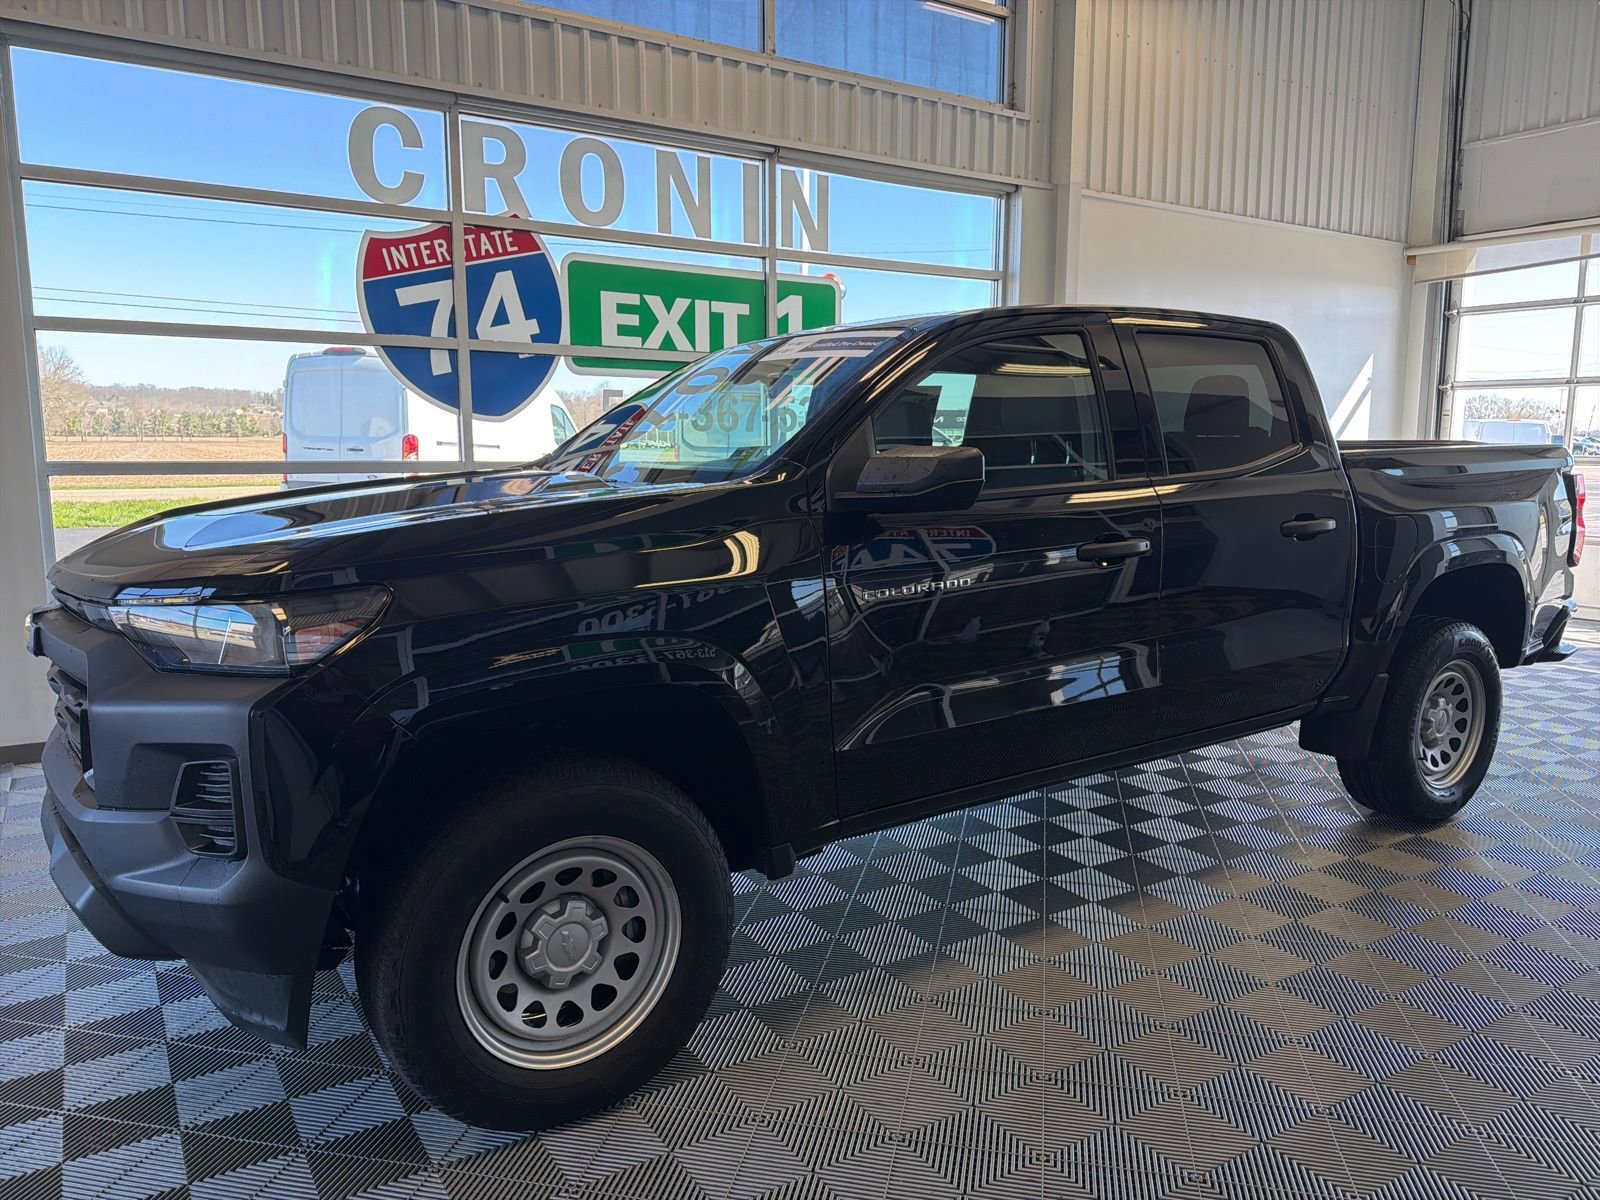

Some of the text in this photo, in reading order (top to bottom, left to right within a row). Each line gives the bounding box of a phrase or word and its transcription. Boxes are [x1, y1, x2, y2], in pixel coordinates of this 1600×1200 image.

[348, 106, 829, 251] CRONIN
[382, 229, 519, 272] INTERTATE
[395, 270, 540, 376] 74
[600, 291, 750, 352] EXIT
[862, 577, 971, 600] COLORADO
